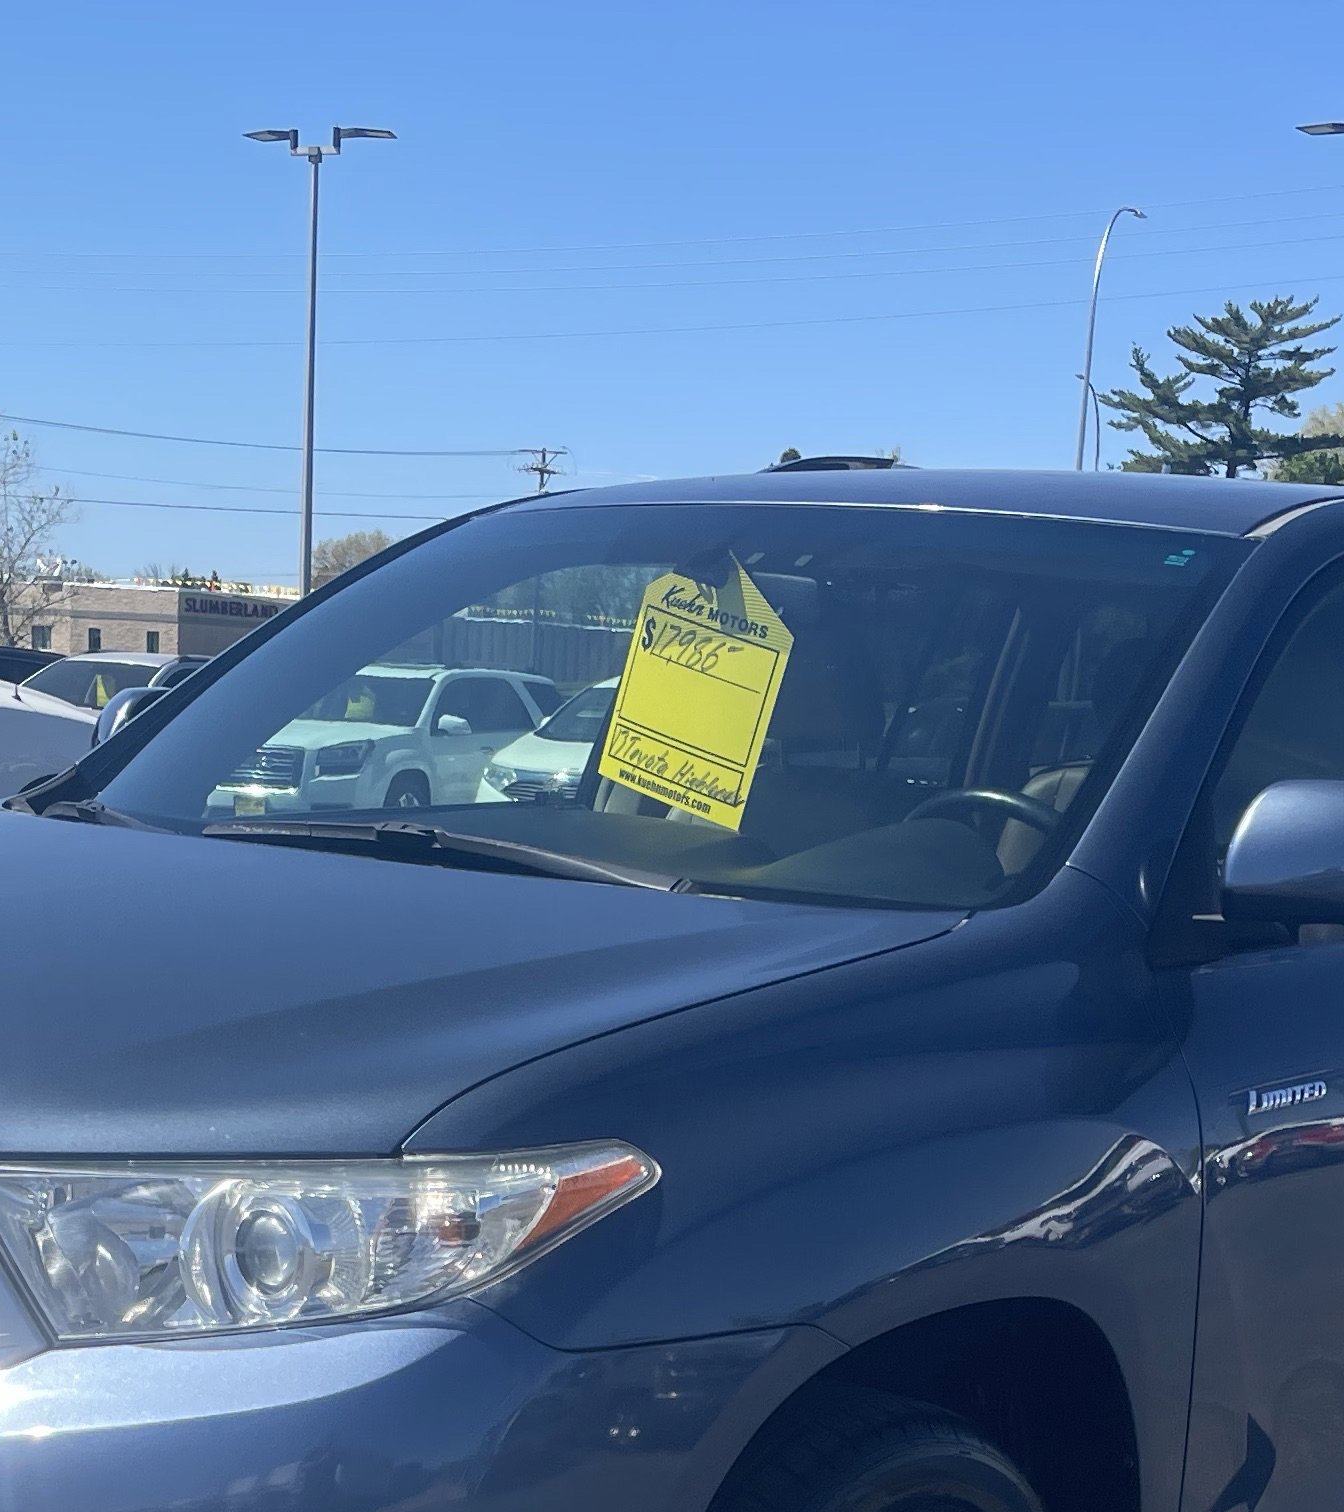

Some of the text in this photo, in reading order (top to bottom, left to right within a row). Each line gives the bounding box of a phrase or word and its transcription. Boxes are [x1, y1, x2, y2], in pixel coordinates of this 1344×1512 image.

[184, 597, 279, 618] SLUMBERLAND
[661, 584, 769, 639] Kuehn MOTORS
[618, 768, 712, 814] www.kuehnmotors.com
